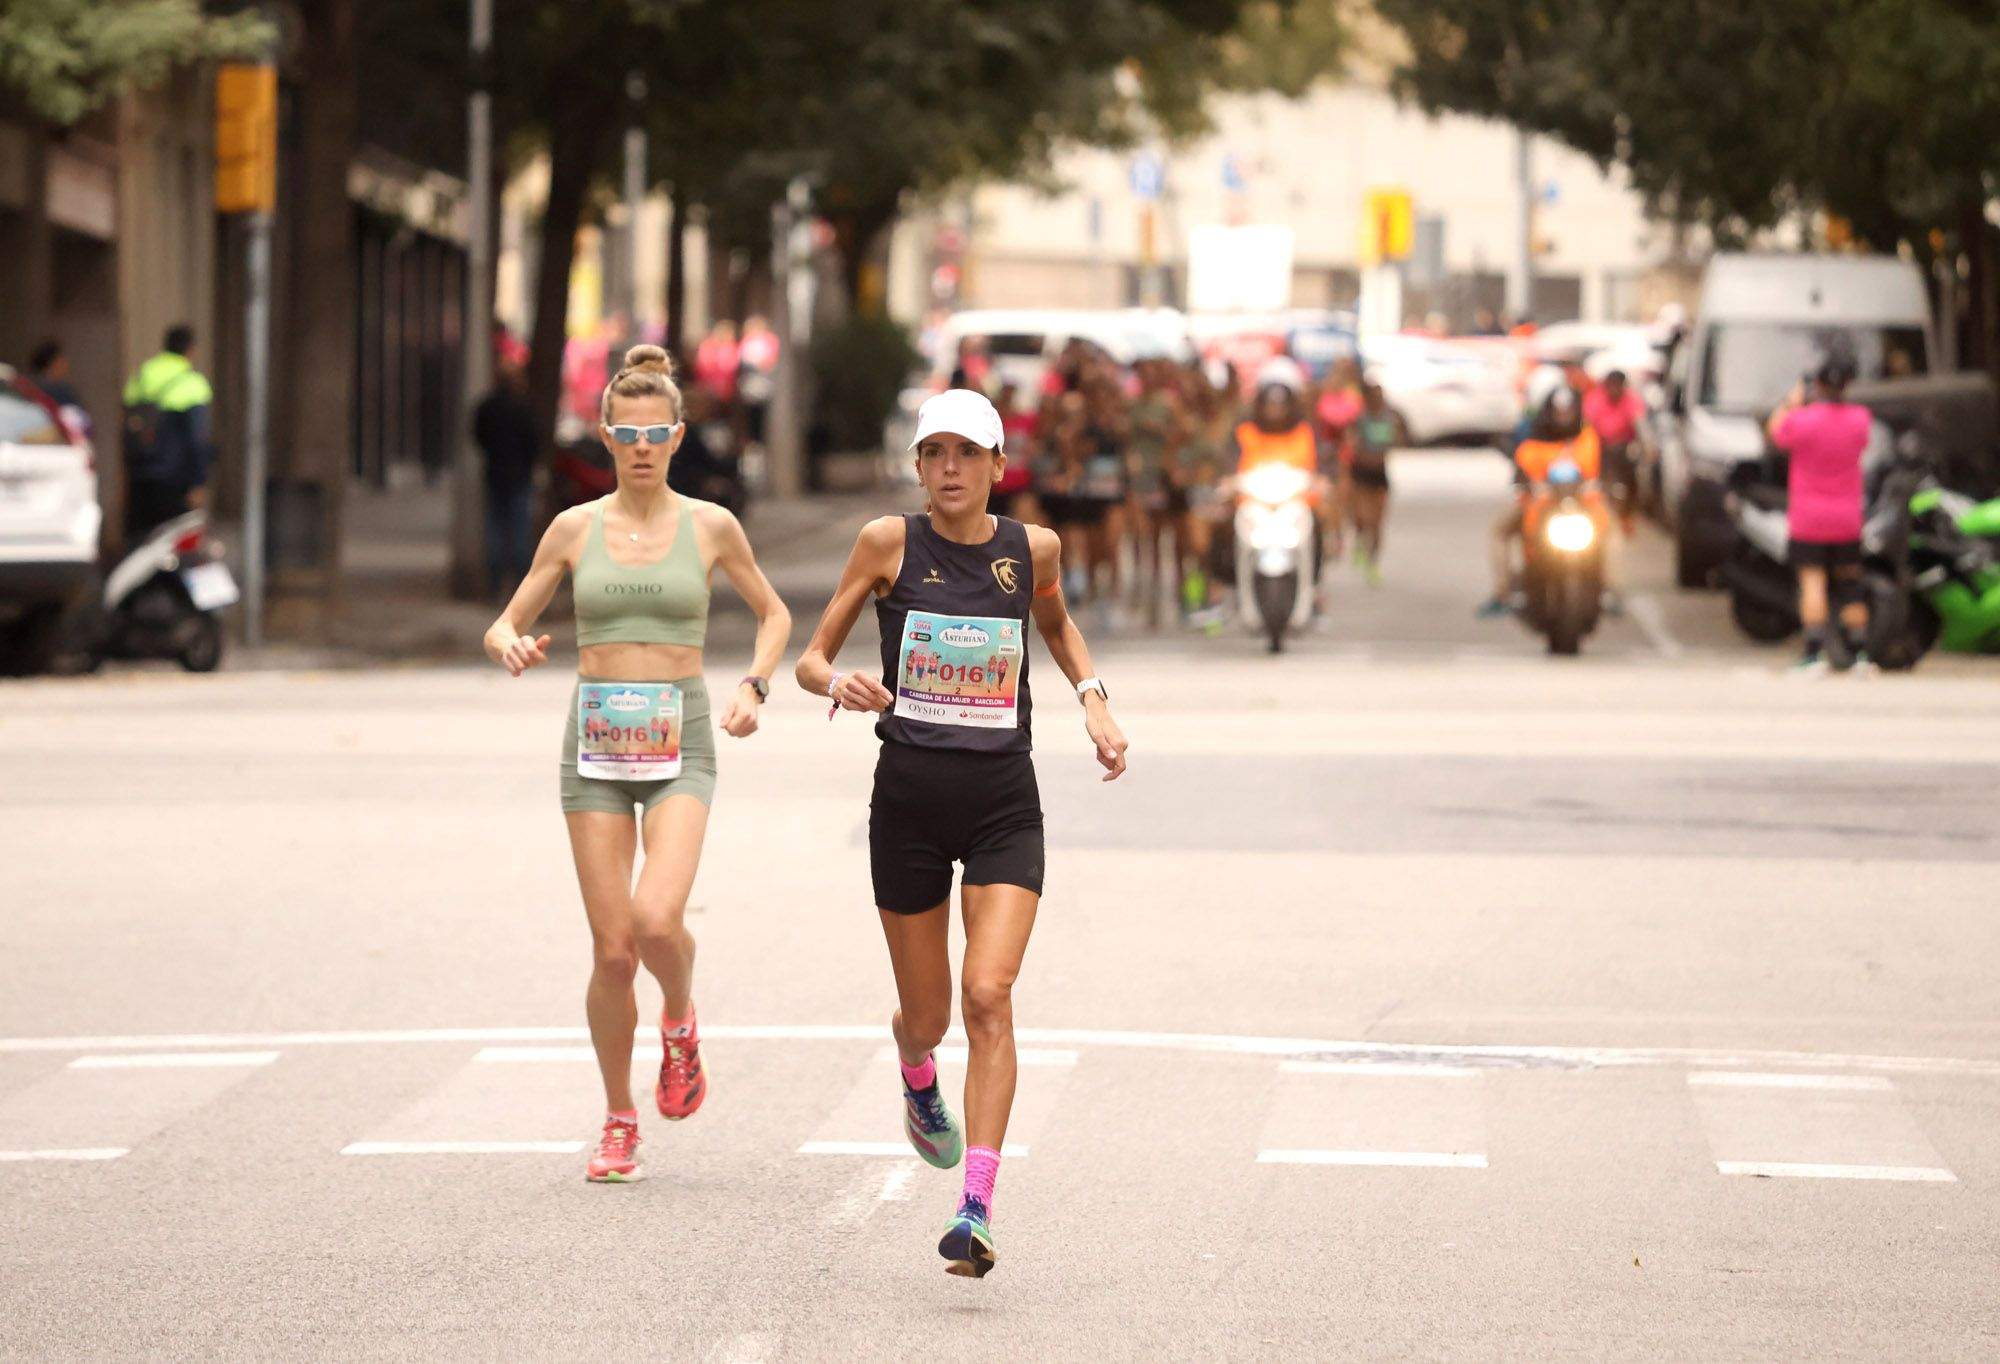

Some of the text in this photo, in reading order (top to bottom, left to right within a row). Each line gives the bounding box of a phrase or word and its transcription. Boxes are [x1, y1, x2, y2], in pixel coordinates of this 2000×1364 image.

[604, 583, 663, 594] OYSHO
[942, 632, 987, 643] ASTURIANA
[939, 663, 984, 683] 016
[909, 691, 934, 701] CARRERA
[951, 696, 971, 704] MUJER
[974, 698, 1006, 706] BARCELONA
[908, 703, 946, 717] OYSHO
[968, 711, 1004, 721] Santander
[610, 726, 648, 742] 016
